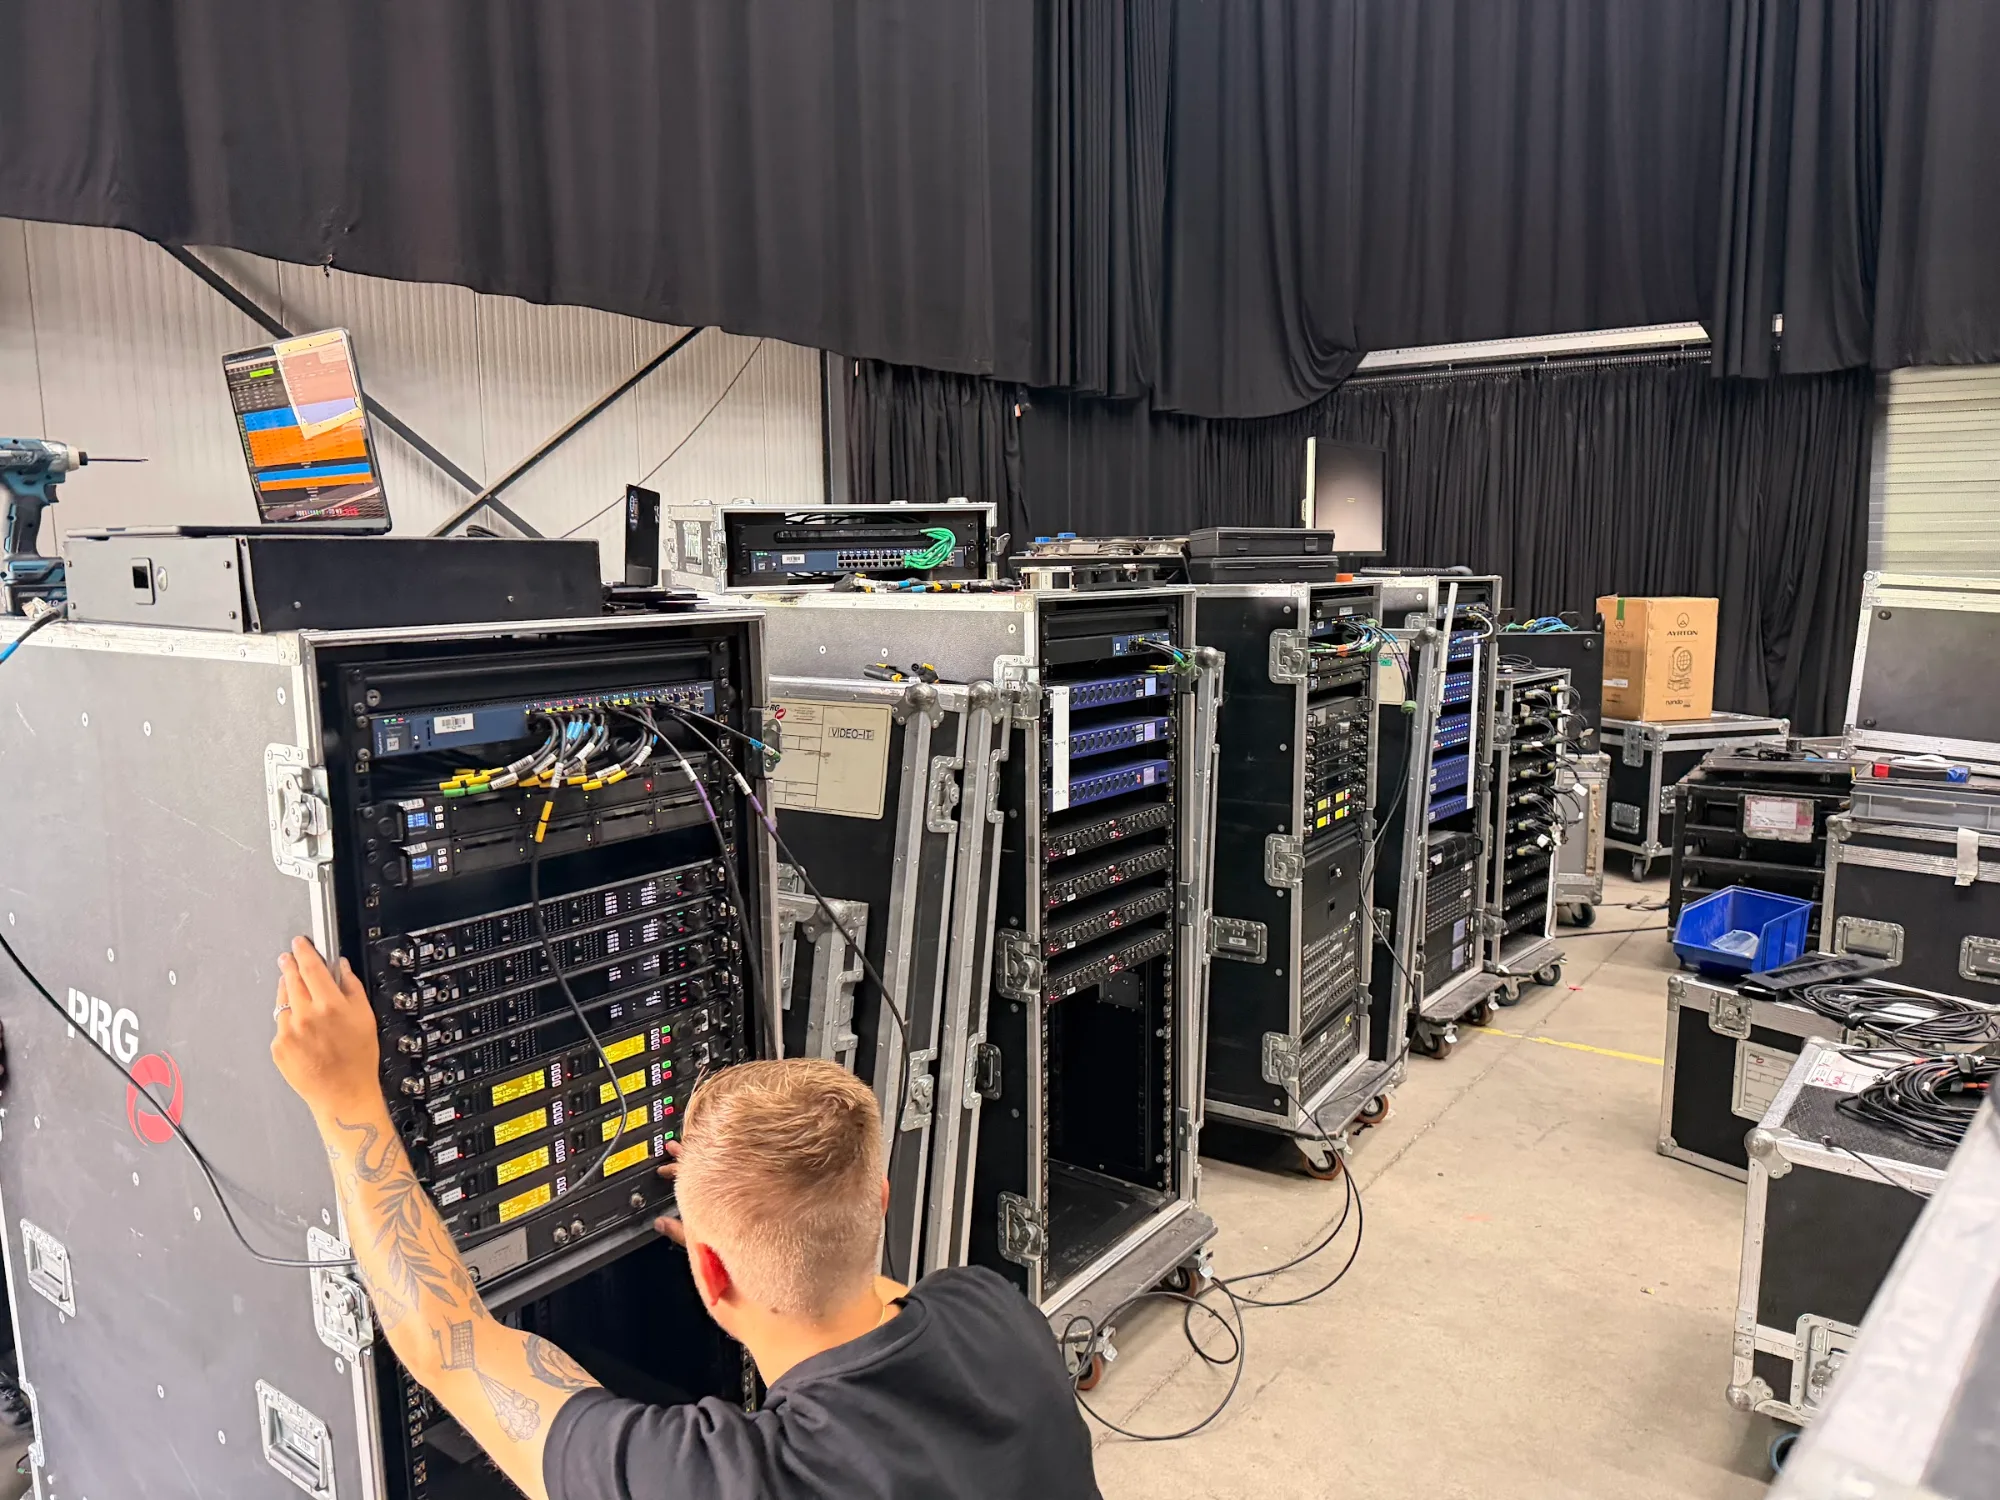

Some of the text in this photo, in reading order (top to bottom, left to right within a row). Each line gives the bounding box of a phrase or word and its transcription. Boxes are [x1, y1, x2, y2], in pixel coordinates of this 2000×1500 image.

[831, 727, 872, 739] VIDEO-IT
[505, 959, 511, 967] 2
[541, 949, 546, 957] 3
[67, 987, 139, 1064] PRG
[510, 1039, 516, 1047] 2
